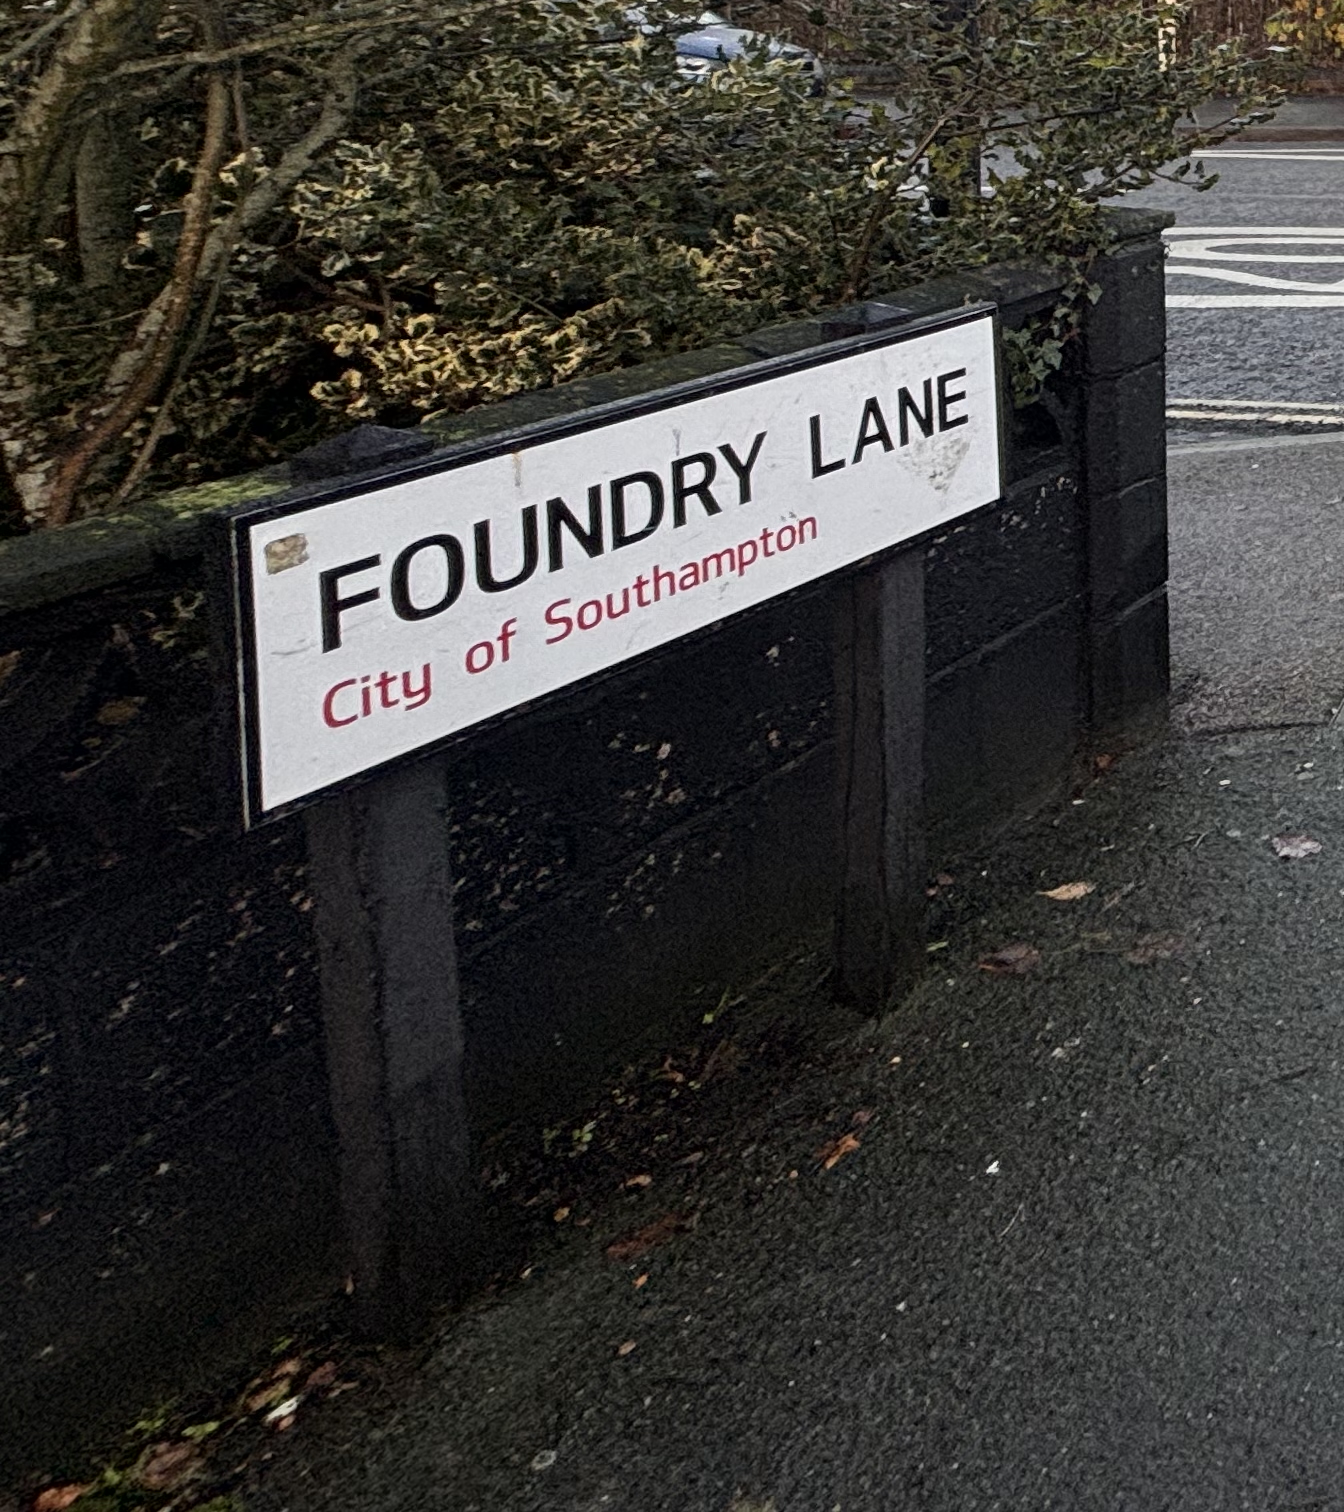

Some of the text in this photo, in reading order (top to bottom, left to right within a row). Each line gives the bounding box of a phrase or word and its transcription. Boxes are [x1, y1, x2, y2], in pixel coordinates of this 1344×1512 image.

[319, 368, 970, 654] FOUNDRY LANE
[322, 515, 818, 729] City of Southampton
